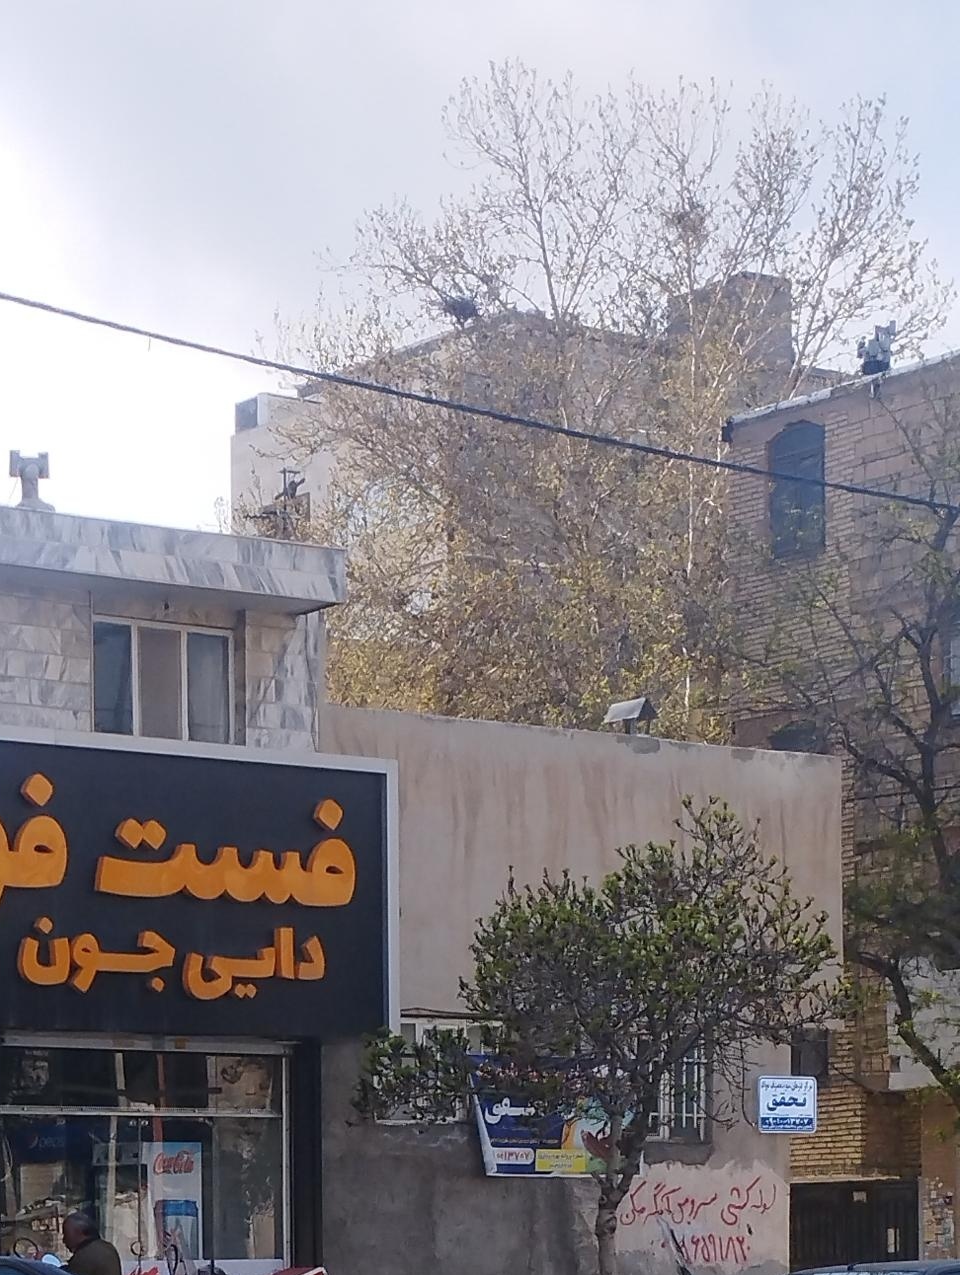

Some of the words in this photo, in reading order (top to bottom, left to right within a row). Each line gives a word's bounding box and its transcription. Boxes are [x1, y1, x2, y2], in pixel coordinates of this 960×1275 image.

[95, 798, 356, 907] فست
[17, 916, 176, 994] جون
[182, 926, 327, 1001] دایی
